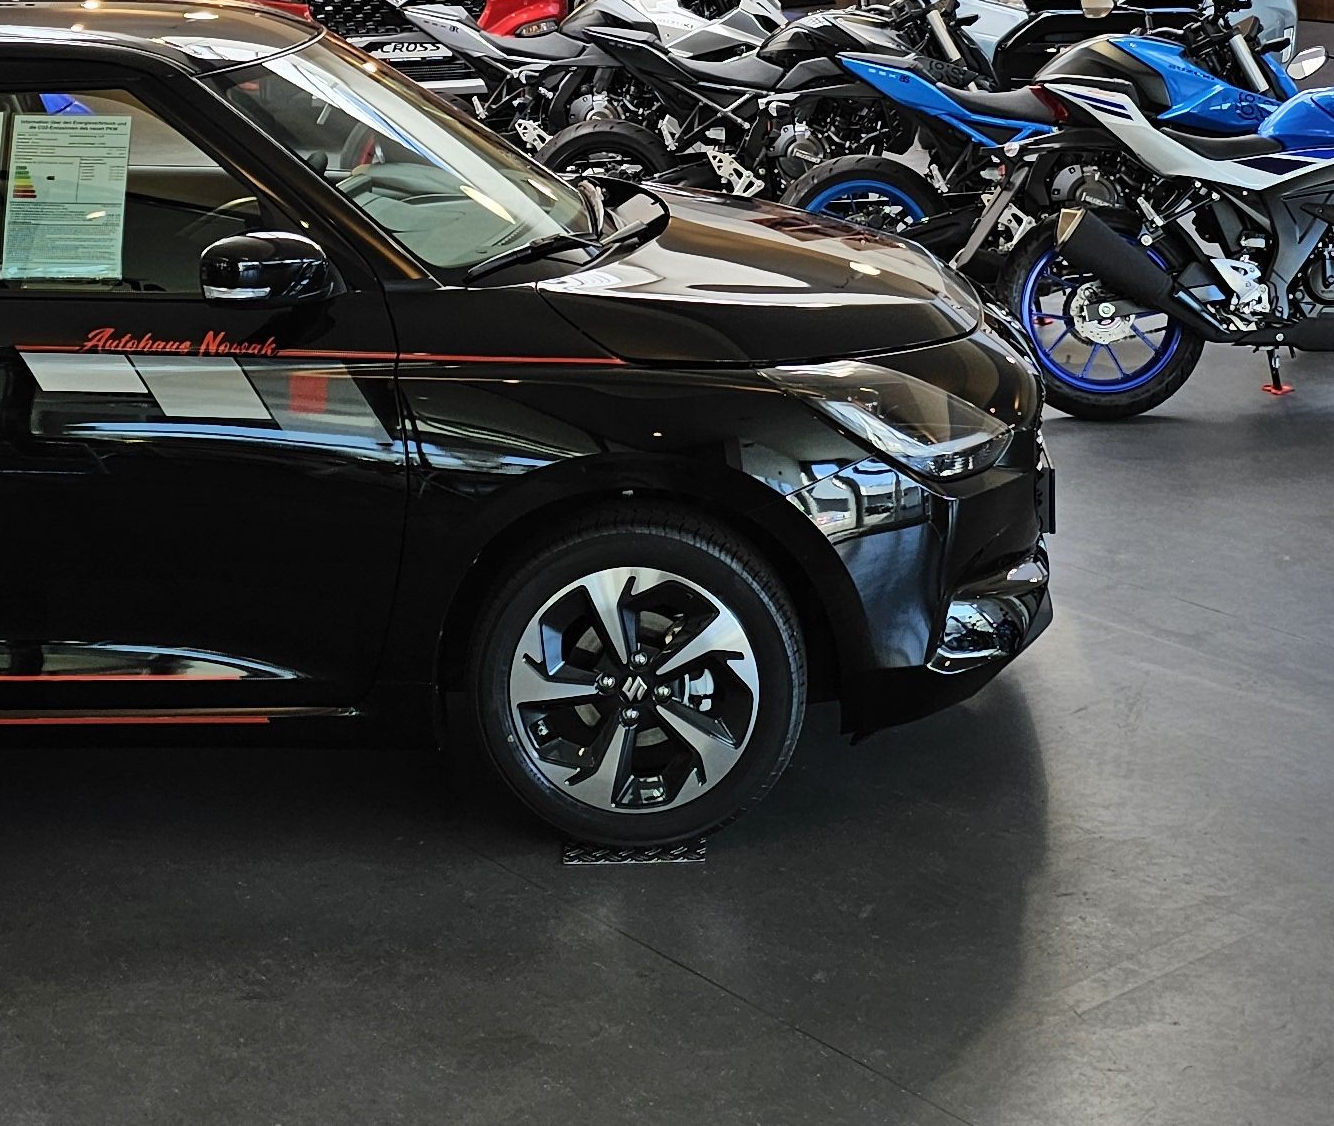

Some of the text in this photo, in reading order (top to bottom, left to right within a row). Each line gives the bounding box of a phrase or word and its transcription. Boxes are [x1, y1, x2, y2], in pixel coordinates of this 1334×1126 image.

[379, 42, 441, 54] CROSS
[80, 327, 280, 357] Autohaus Nowak
